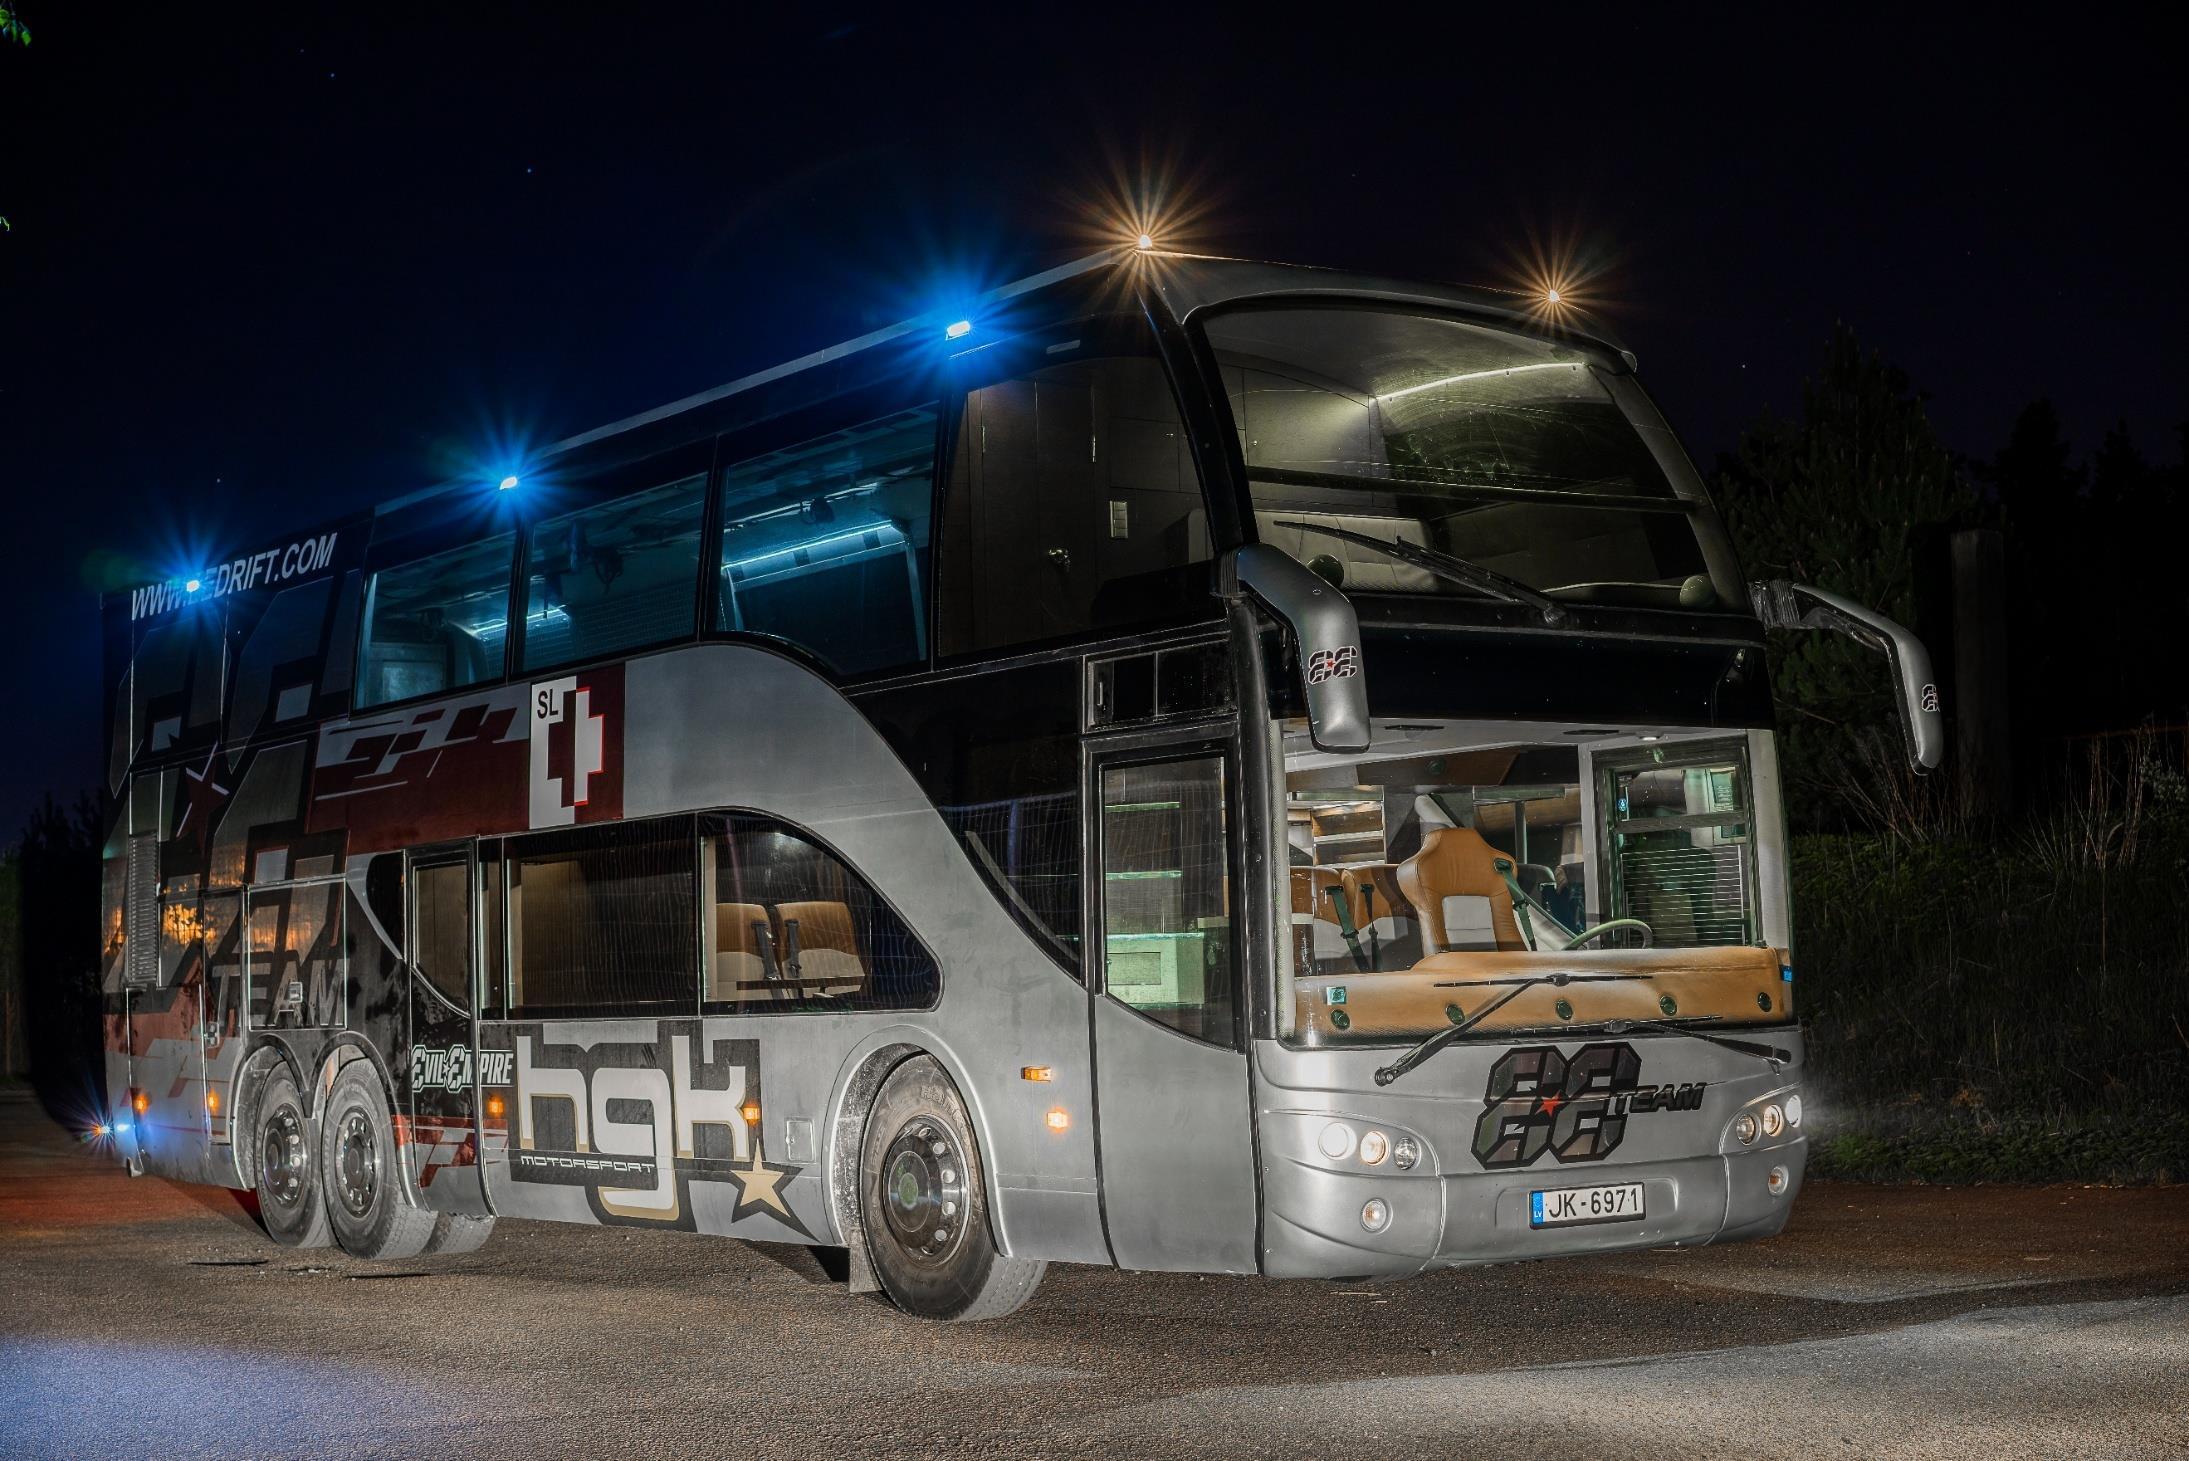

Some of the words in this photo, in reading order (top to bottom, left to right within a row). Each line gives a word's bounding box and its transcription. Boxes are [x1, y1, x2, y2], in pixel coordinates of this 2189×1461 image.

[537, 688, 559, 719] SL
[212, 958, 350, 1028] TEAM
[1471, 1042, 1643, 1170] 88
[1607, 1082, 1707, 1117] TEAM
[520, 1155, 656, 1174] MOTORSPORT
[1534, 1211, 1543, 1219] LV
[1549, 1187, 1639, 1218] JK-6971
